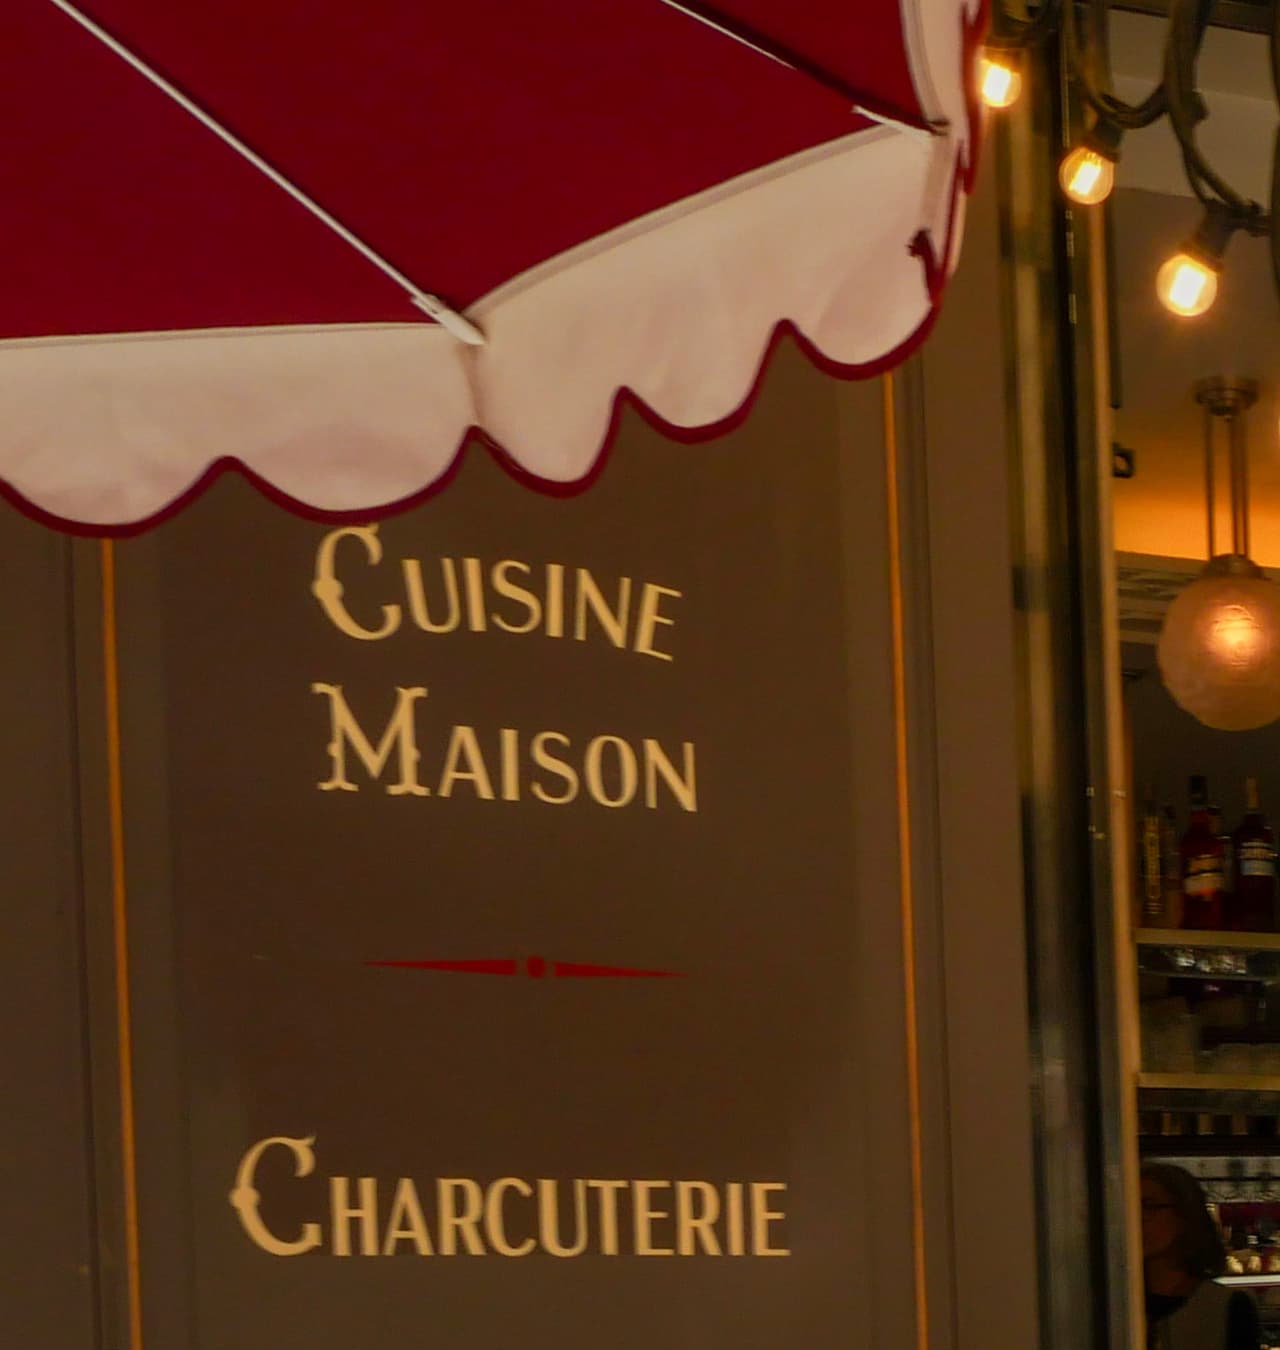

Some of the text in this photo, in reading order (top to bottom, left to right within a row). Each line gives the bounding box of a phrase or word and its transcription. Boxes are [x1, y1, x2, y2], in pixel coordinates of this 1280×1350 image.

[311, 524, 683, 662] CUISINE
[310, 682, 699, 812] MAISON
[229, 1134, 790, 1257] CHARCUTERIE
